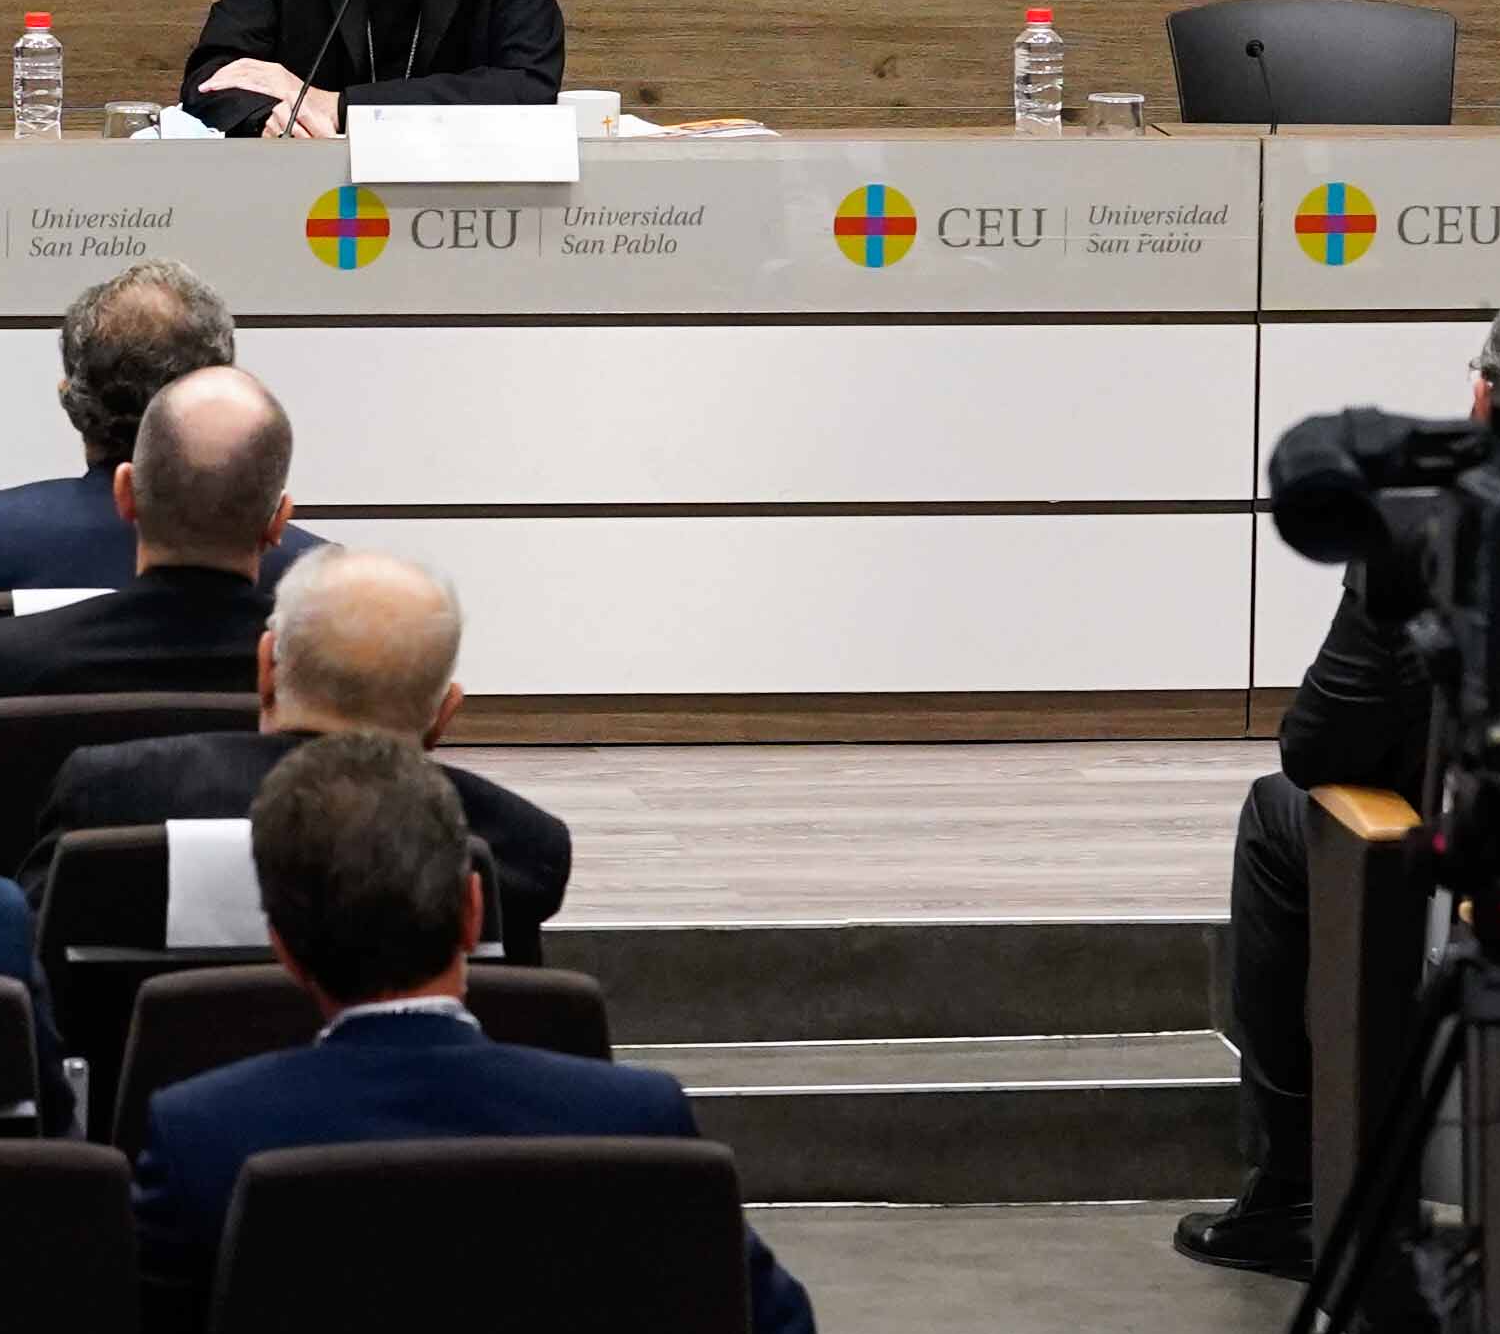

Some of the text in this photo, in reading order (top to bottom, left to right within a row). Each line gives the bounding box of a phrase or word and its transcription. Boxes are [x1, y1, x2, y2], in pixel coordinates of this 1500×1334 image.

[31, 208, 173, 229] Universidad
[563, 206, 705, 226] Universidad
[1087, 205, 1228, 225] Universidad
[411, 209, 521, 249] CEU
[937, 208, 1047, 247] CEU
[28, 236, 146, 257] San Pablo
[561, 235, 678, 254] San Pablo
[1086, 233, 1130, 253] San
